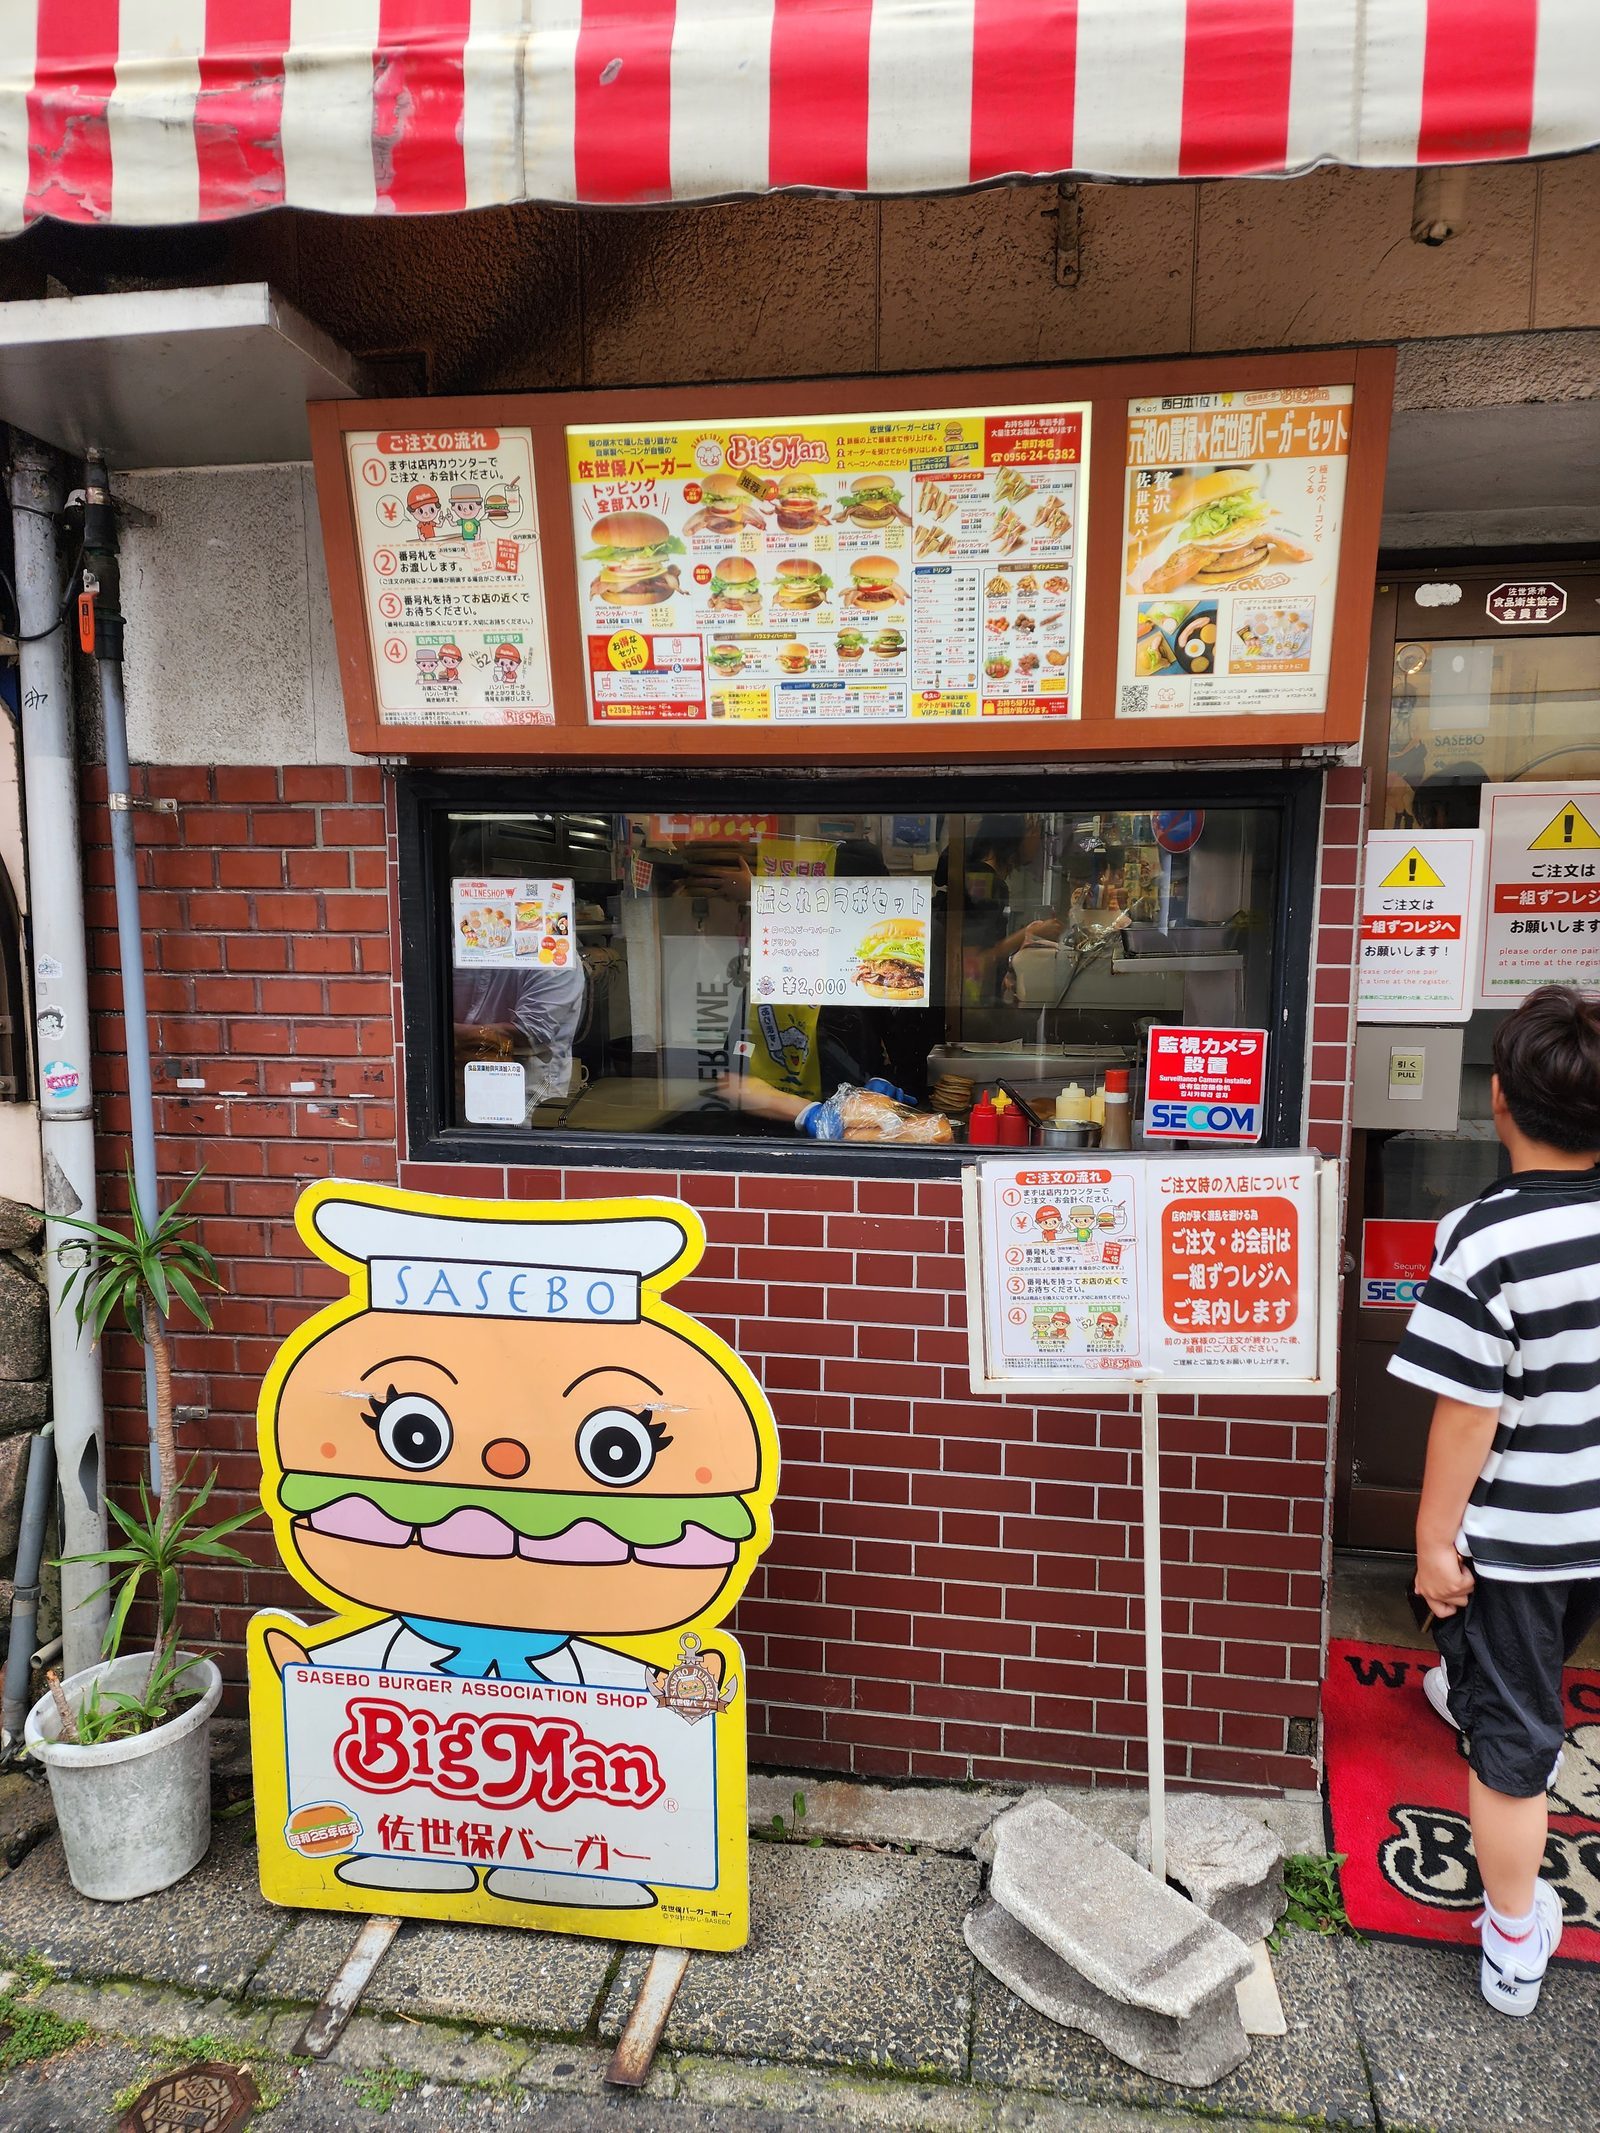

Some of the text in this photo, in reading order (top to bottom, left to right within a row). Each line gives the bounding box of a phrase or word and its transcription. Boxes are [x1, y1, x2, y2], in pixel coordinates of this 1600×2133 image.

[389, 434, 487, 451] ご注文の流れ
[1004, 448, 1076, 462] 0956-24-6382
[388, 458, 498, 470] まずは店内カウンターで
[578, 458, 691, 478] 佐世保バーガー
[390, 470, 506, 482] ご注文・お会計ください。
[1305, 465, 1316, 494] つくる
[592, 480, 656, 498] トッピング
[1153, 471, 1173, 514] 贅沢
[1313, 465, 1328, 542] 極上のベーコンで
[399, 550, 436, 561] 番号札を
[400, 562, 464, 573] お渡しします。
[506, 560, 516, 569] 15
[1508, 586, 1547, 596] 佐世保市
[404, 592, 530, 606] 番号札を持ってお店の近くで
[405, 606, 478, 617] お待ちください。
[1503, 608, 1548, 620] 会員証
[612, 635, 637, 651] お得な
[618, 646, 638, 657] セット
[621, 654, 643, 670] ¥550
[1434, 734, 1485, 747] SASEBO
[1532, 864, 1596, 878] ご注文は
[756, 884, 925, 915] 艦これコラボセット
[1382, 899, 1434, 911] ご注文は
[1360, 920, 1456, 934] 一組ずつレジへ
[1500, 948, 1529, 956] please
[1581, 947, 1599, 956] pair
[1520, 958, 1540, 966] time
[1558, 958, 1572, 966] the
[1424, 968, 1438, 976] pair
[782, 976, 846, 997] ¥2,000
[1158, 1036, 1257, 1056] 監視カメラ
[1184, 1056, 1228, 1074] 設置
[1198, 1076, 1222, 1084] Camera
[1152, 1104, 1254, 1132] SECOM
[1025, 1172, 1102, 1184] ご注文の流れ
[1161, 1176, 1300, 1194] ご注文時の入店について
[1024, 1188, 1110, 1196] まずは店内カウンターで
[1024, 1196, 1114, 1205] ご注文・お会計ください。
[1172, 1227, 1291, 1256] ご注文・お会計は
[1026, 1248, 1056, 1256] 番号札を
[1026, 1256, 1076, 1264] お渡しします。
[1394, 1262, 1426, 1271] Security
[1172, 1262, 1291, 1290] 一組ずつレジへ
[1404, 1270, 1414, 1278] by
[1027, 1278, 1128, 1286] 番号札を持ってお店の近くで
[395, 1265, 615, 1316] SASEBO
[1028, 1286, 1085, 1294] お待ちください。
[1173, 1298, 1291, 1326] ご案内します
[1164, 1336, 1300, 1346] 前のお客様のご注文が終わった後、
[1186, 1345, 1279, 1354] 順番にご入店ください。
[1172, 1358, 1290, 1366] ご理解とご協力をお願い申し上げます。
[296, 1669, 648, 1709] SASEBO BURGER ASSOCIATION SHOP
[290, 1822, 360, 1846] 昭和25年伝来
[378, 1814, 651, 1872] 佐世保バーガー
[660, 1904, 732, 1918] 佐世保バーガーボーイ
[1495, 1979, 1520, 1998] NIKE
